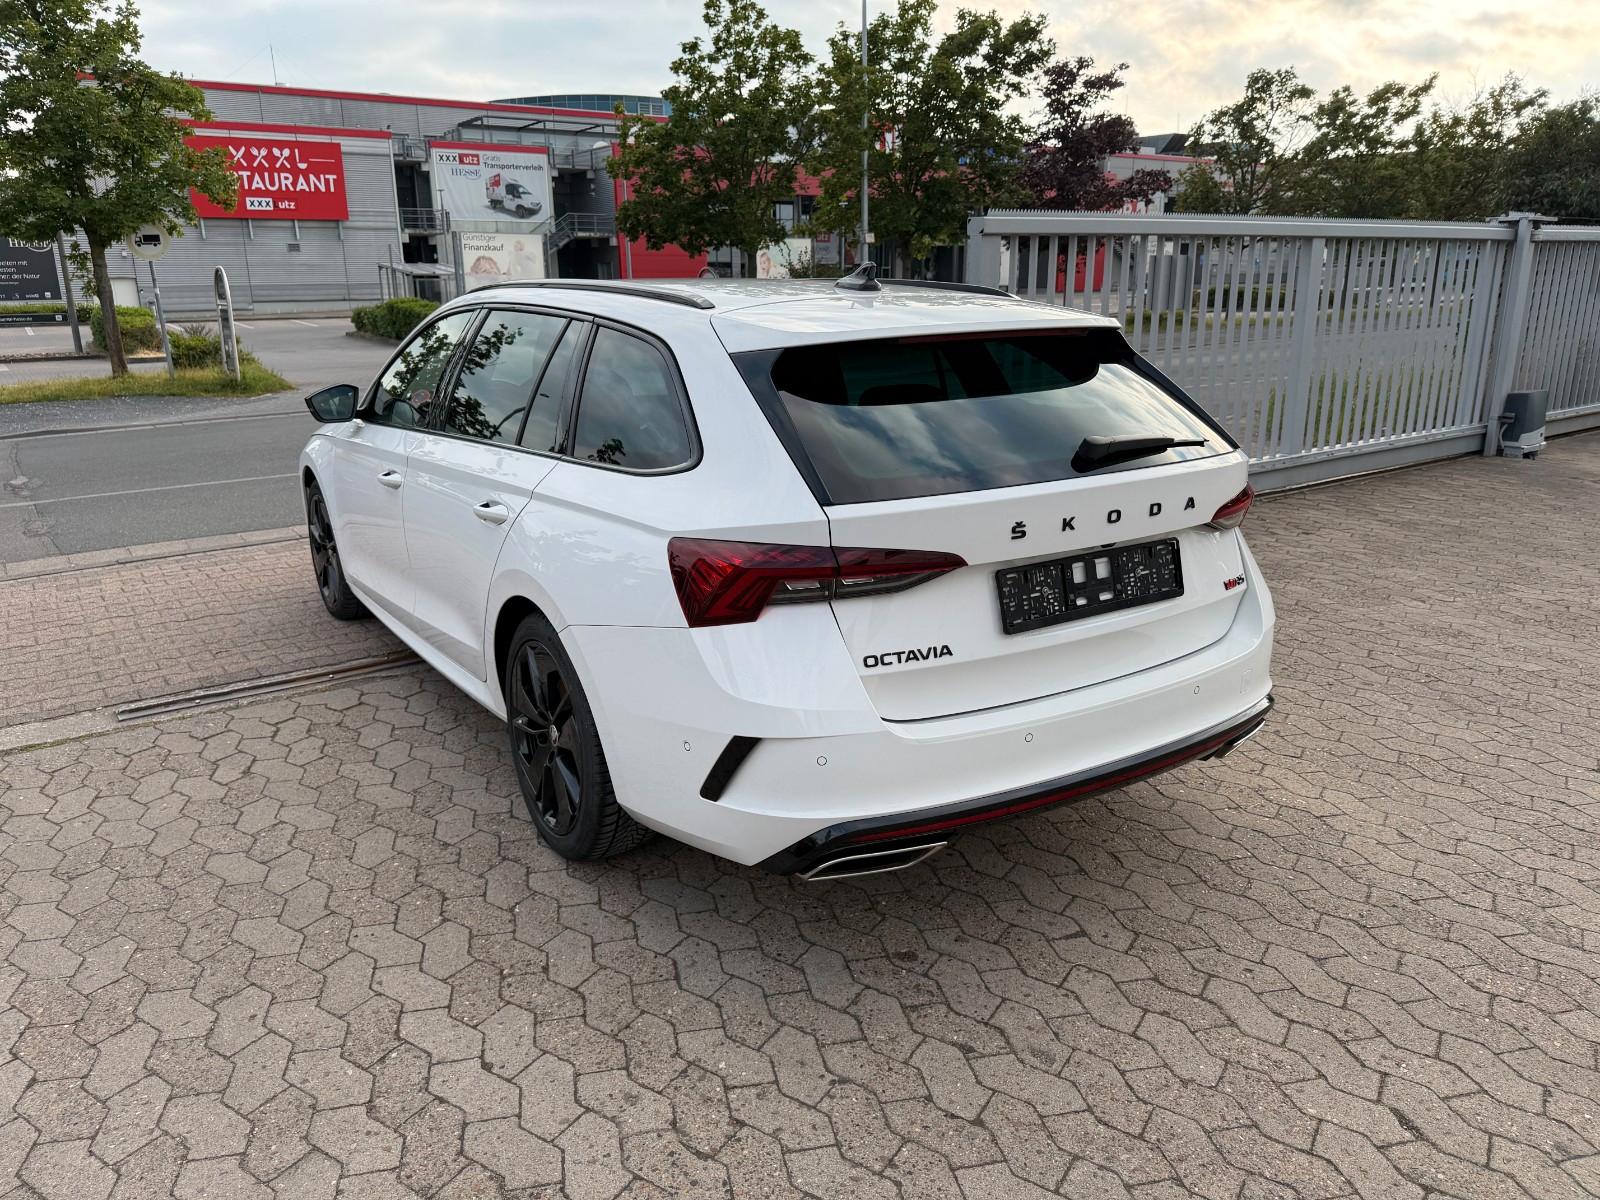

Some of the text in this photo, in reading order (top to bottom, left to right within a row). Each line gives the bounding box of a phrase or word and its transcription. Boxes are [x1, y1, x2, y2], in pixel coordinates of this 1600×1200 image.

[484, 162, 544, 172] Transporterverleih
[233, 170, 337, 193] TAURANT
[463, 233, 497, 242] Günstiger
[464, 243, 504, 252] Finanzkauf
[863, 644, 953, 668] OCTAVIA
